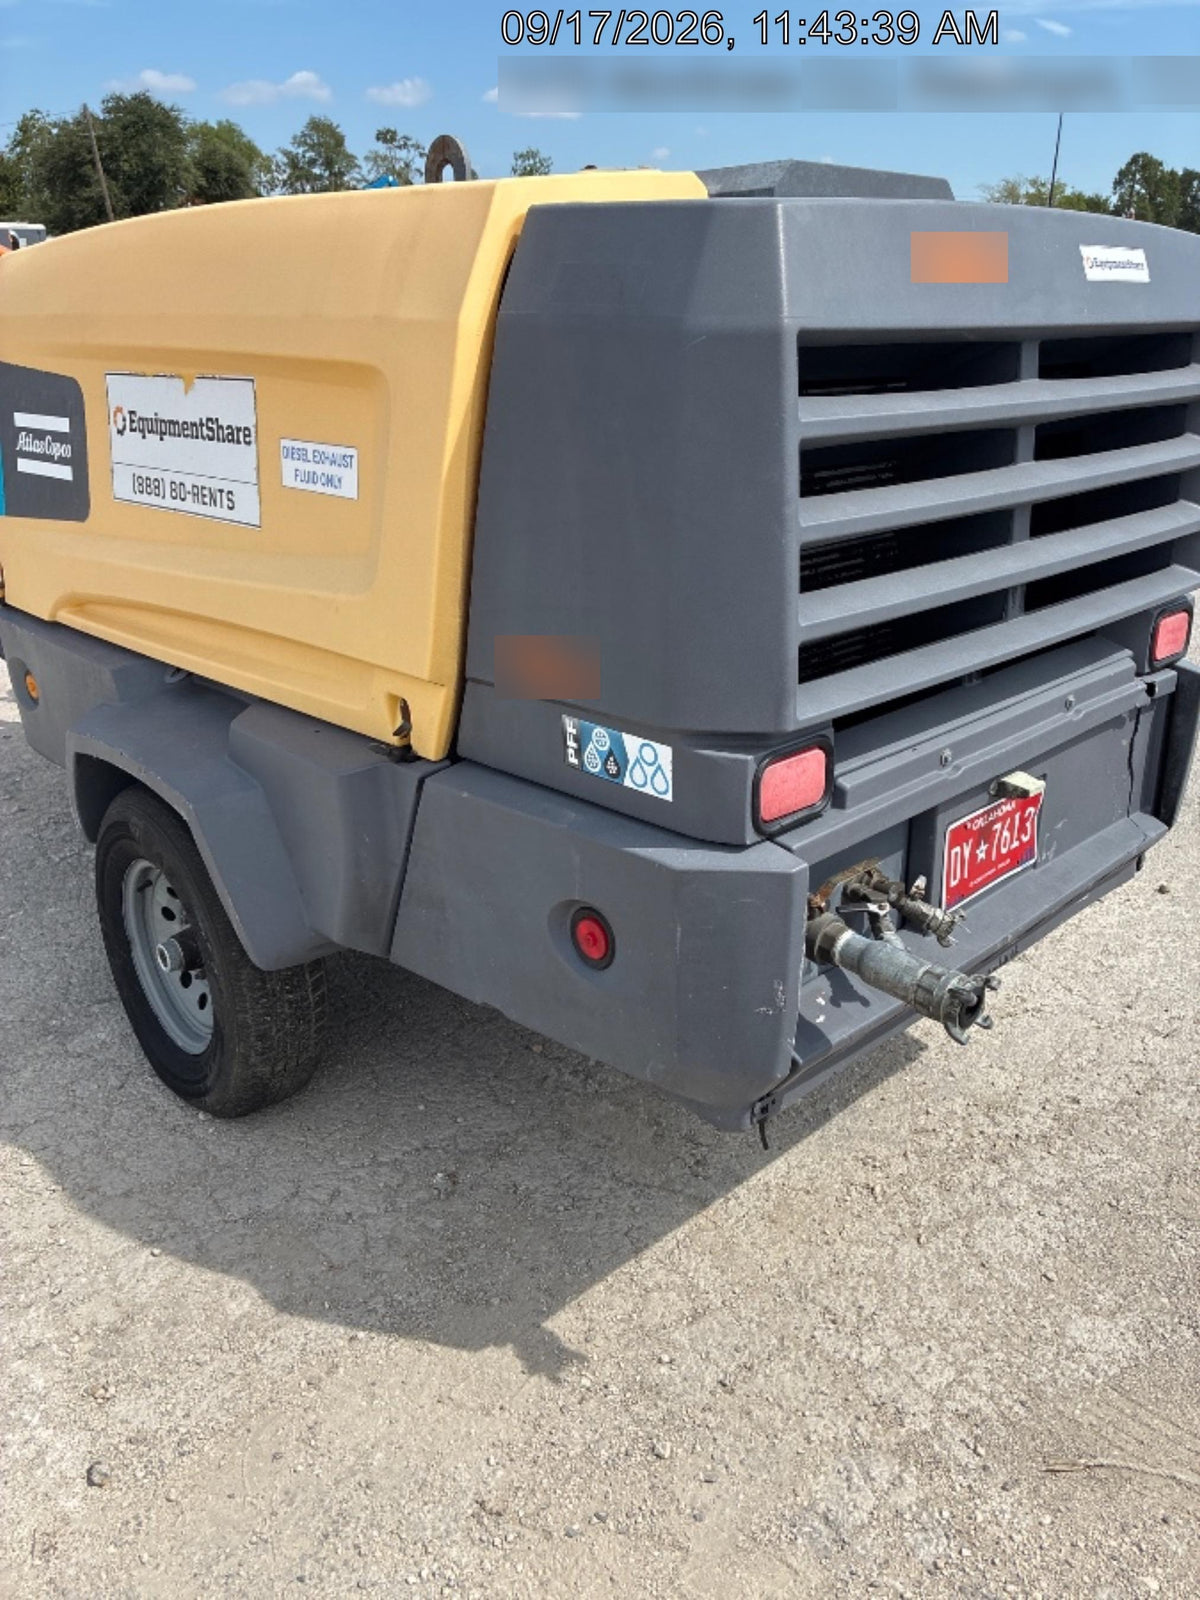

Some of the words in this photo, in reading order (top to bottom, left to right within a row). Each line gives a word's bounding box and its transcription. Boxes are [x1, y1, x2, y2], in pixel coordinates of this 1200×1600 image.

[128, 410, 252, 446] EquipmentShare
[16, 431, 45, 454] Atlas
[45, 435, 72, 461] Copco
[282, 445, 311, 463] DIESEL
[312, 449, 354, 469] EXHAUST
[132, 473, 166, 500] (888)
[170, 480, 236, 511] 80-RENTS
[294, 468, 319, 486] FLUID
[949, 837, 974, 888] DY
[991, 806, 1036, 862] 7613
